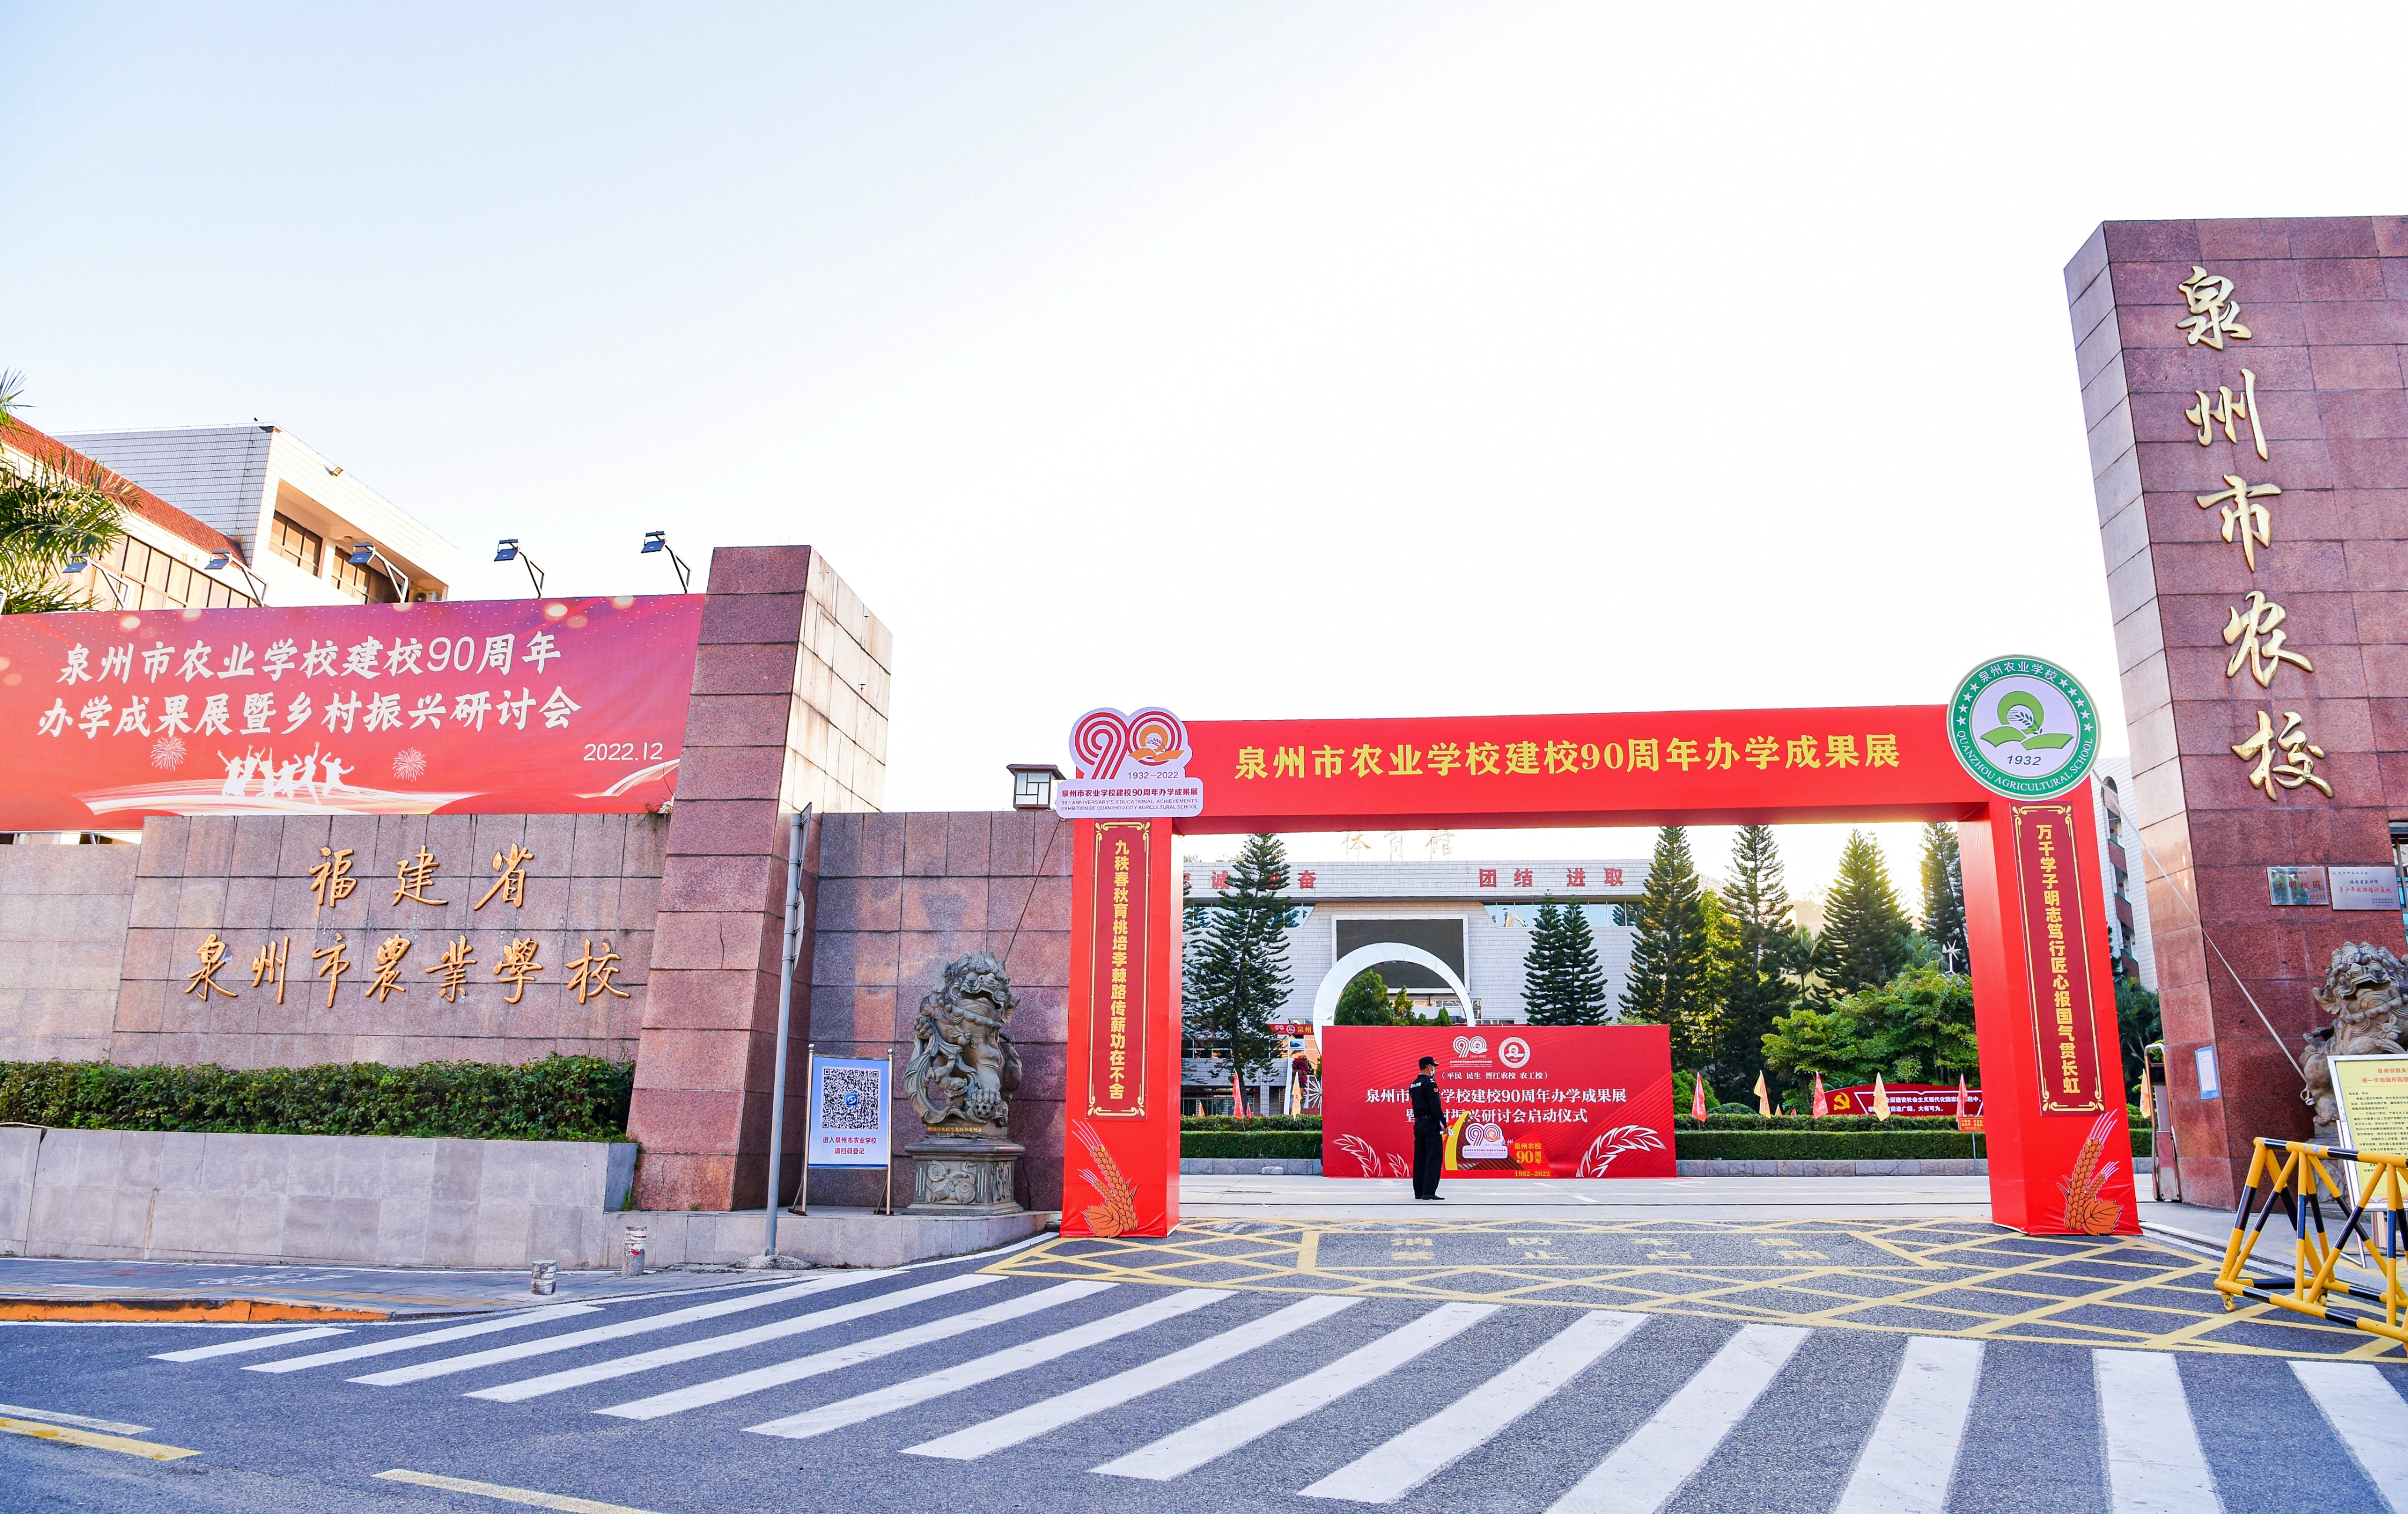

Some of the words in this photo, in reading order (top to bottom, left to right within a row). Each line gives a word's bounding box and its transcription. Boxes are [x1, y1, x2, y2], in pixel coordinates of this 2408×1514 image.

[2177, 266, 2333, 801] 泉州市农校
[56, 632, 561, 687] 泉州市农业学校建校90周年
[1978, 661, 2058, 683] 泉州农业学校
[37, 685, 583, 739] 办学成果展暨乡村振兴研讨会
[584, 741, 663, 762] 2022.12
[1234, 733, 1901, 780] 泉州市农业学校建校90周年办学成果展
[1956, 731, 1996, 780] QUANZHOU
[1995, 772, 2073, 791] AGRICULTURAL
[2071, 738, 2092, 775] SCHOOL
[2006, 755, 2041, 766] 1932
[1062, 788, 1198, 798] 泉州市农业学校建校90周年办学成果展
[309, 842, 533, 910] 福建省
[1479, 869, 1533, 887] 团结
[1567, 869, 1623, 886] 进取
[2277, 880, 2321, 890] 文明校园
[1109, 840, 1130, 1099] 九秩春秋育桃培李棘路传薪功在不舍
[2036, 824, 2081, 1094] 万千学子明志笃行匠心报国气贯长虹
[185, 933, 630, 1009] 泉州市農業學校
[1365, 1088, 1627, 1103] 泉州市学校建校90周年办学成果展
[1406, 1108, 1588, 1123] 暨振兴研讨会启动仪式
[822, 1136, 877, 1144] 进入泉州市农业学校
[1516, 1151, 1534, 1164] 90
[1535, 1151, 1542, 1165] 周年
